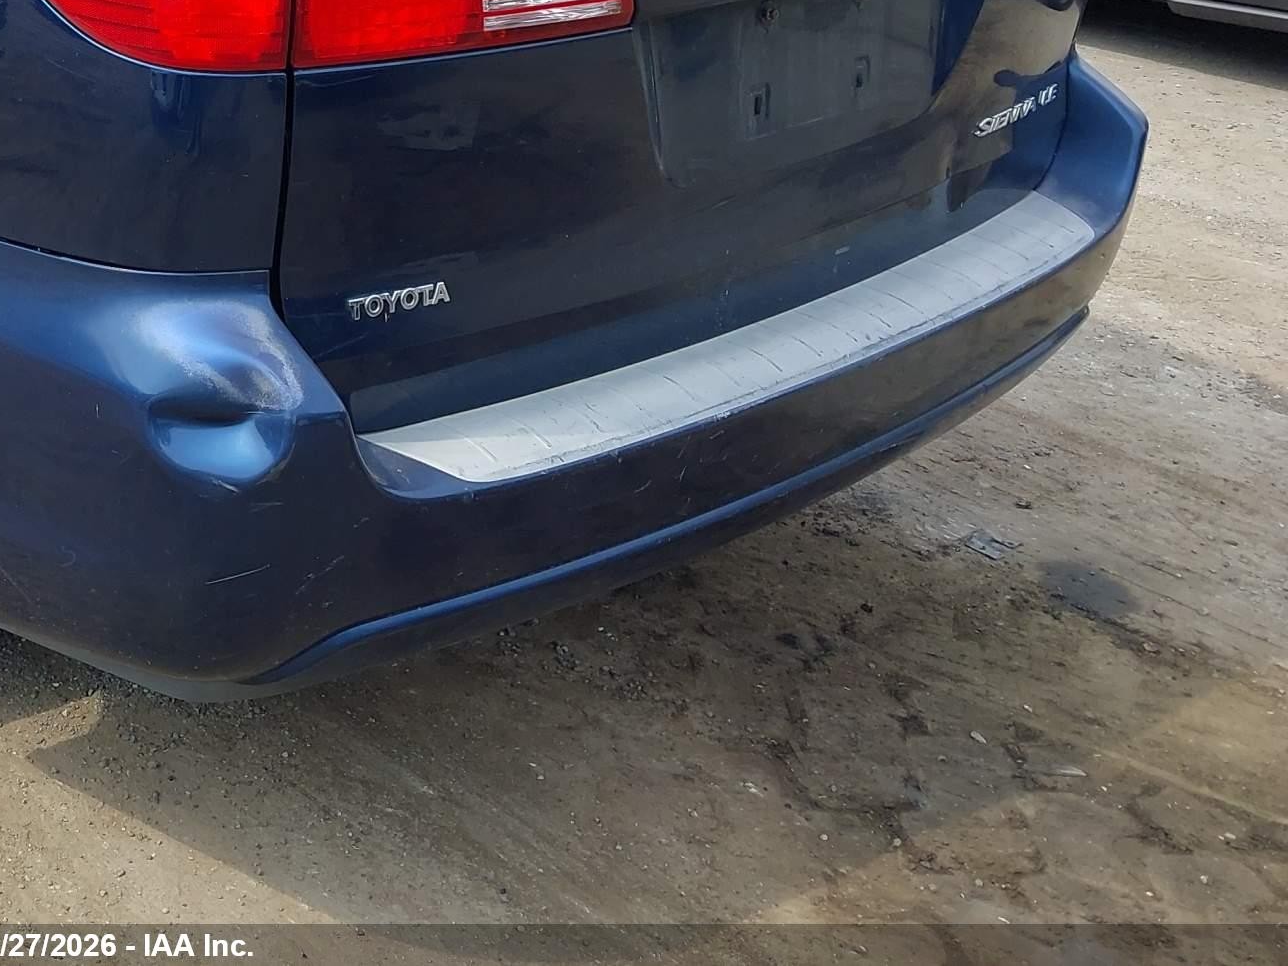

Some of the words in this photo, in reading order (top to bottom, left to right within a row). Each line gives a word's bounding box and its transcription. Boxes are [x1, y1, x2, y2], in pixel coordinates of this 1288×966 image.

[973, 96, 1037, 137] SIENNA
[1037, 83, 1058, 106] LE
[347, 281, 451, 321] TOYOTA
